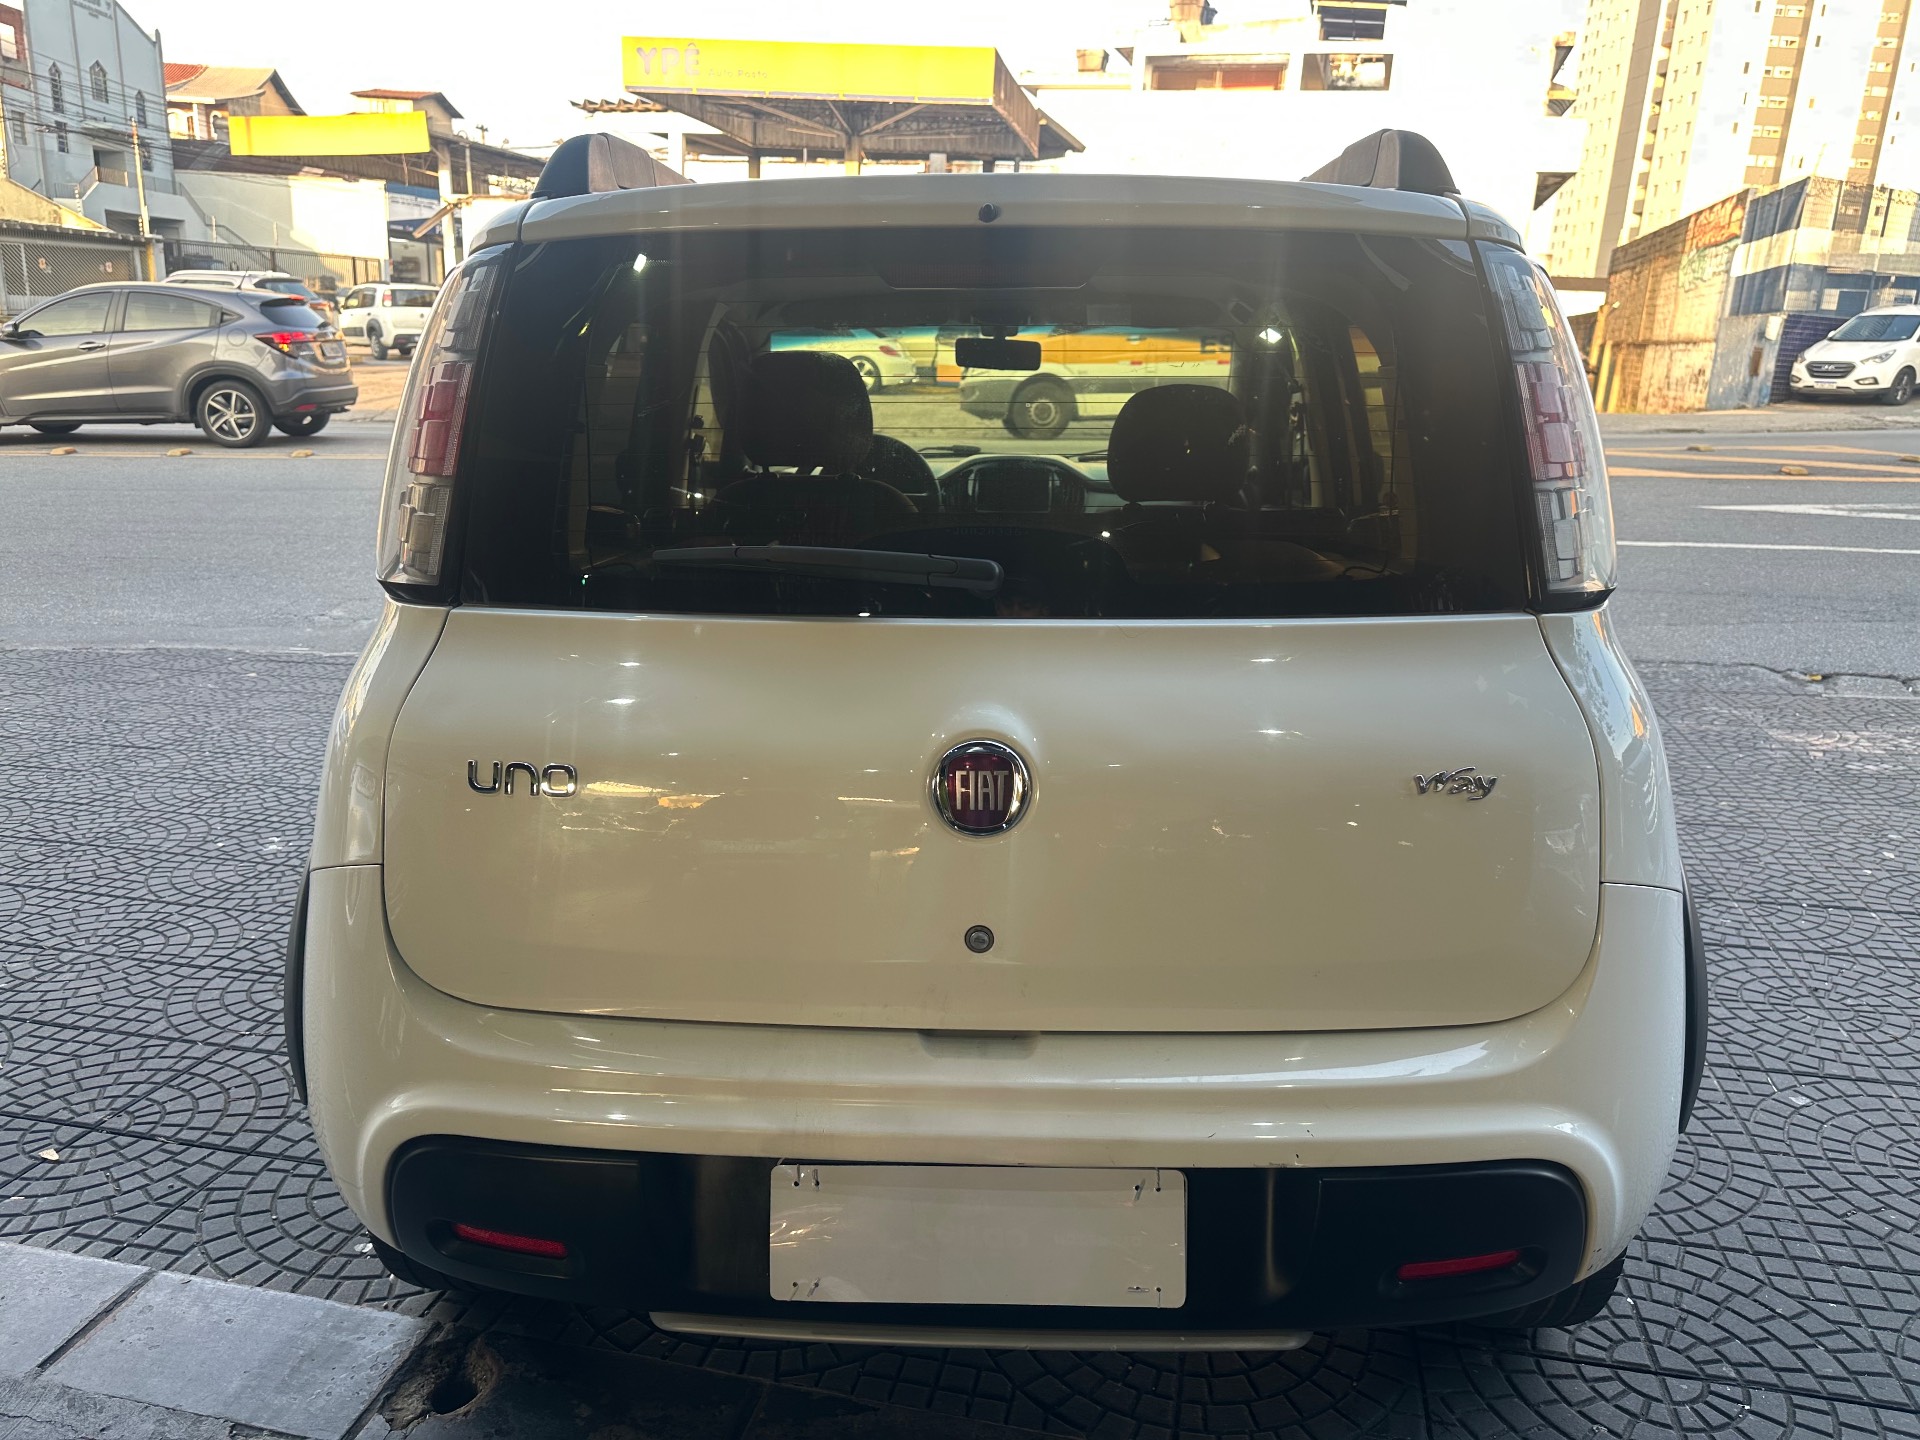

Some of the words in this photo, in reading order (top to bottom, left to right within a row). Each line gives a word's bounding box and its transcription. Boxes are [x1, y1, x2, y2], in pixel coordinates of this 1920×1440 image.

[636, 43, 700, 76] YPÊ
[955, 770, 1009, 811] FIAT
[1414, 766, 1498, 801] Way
